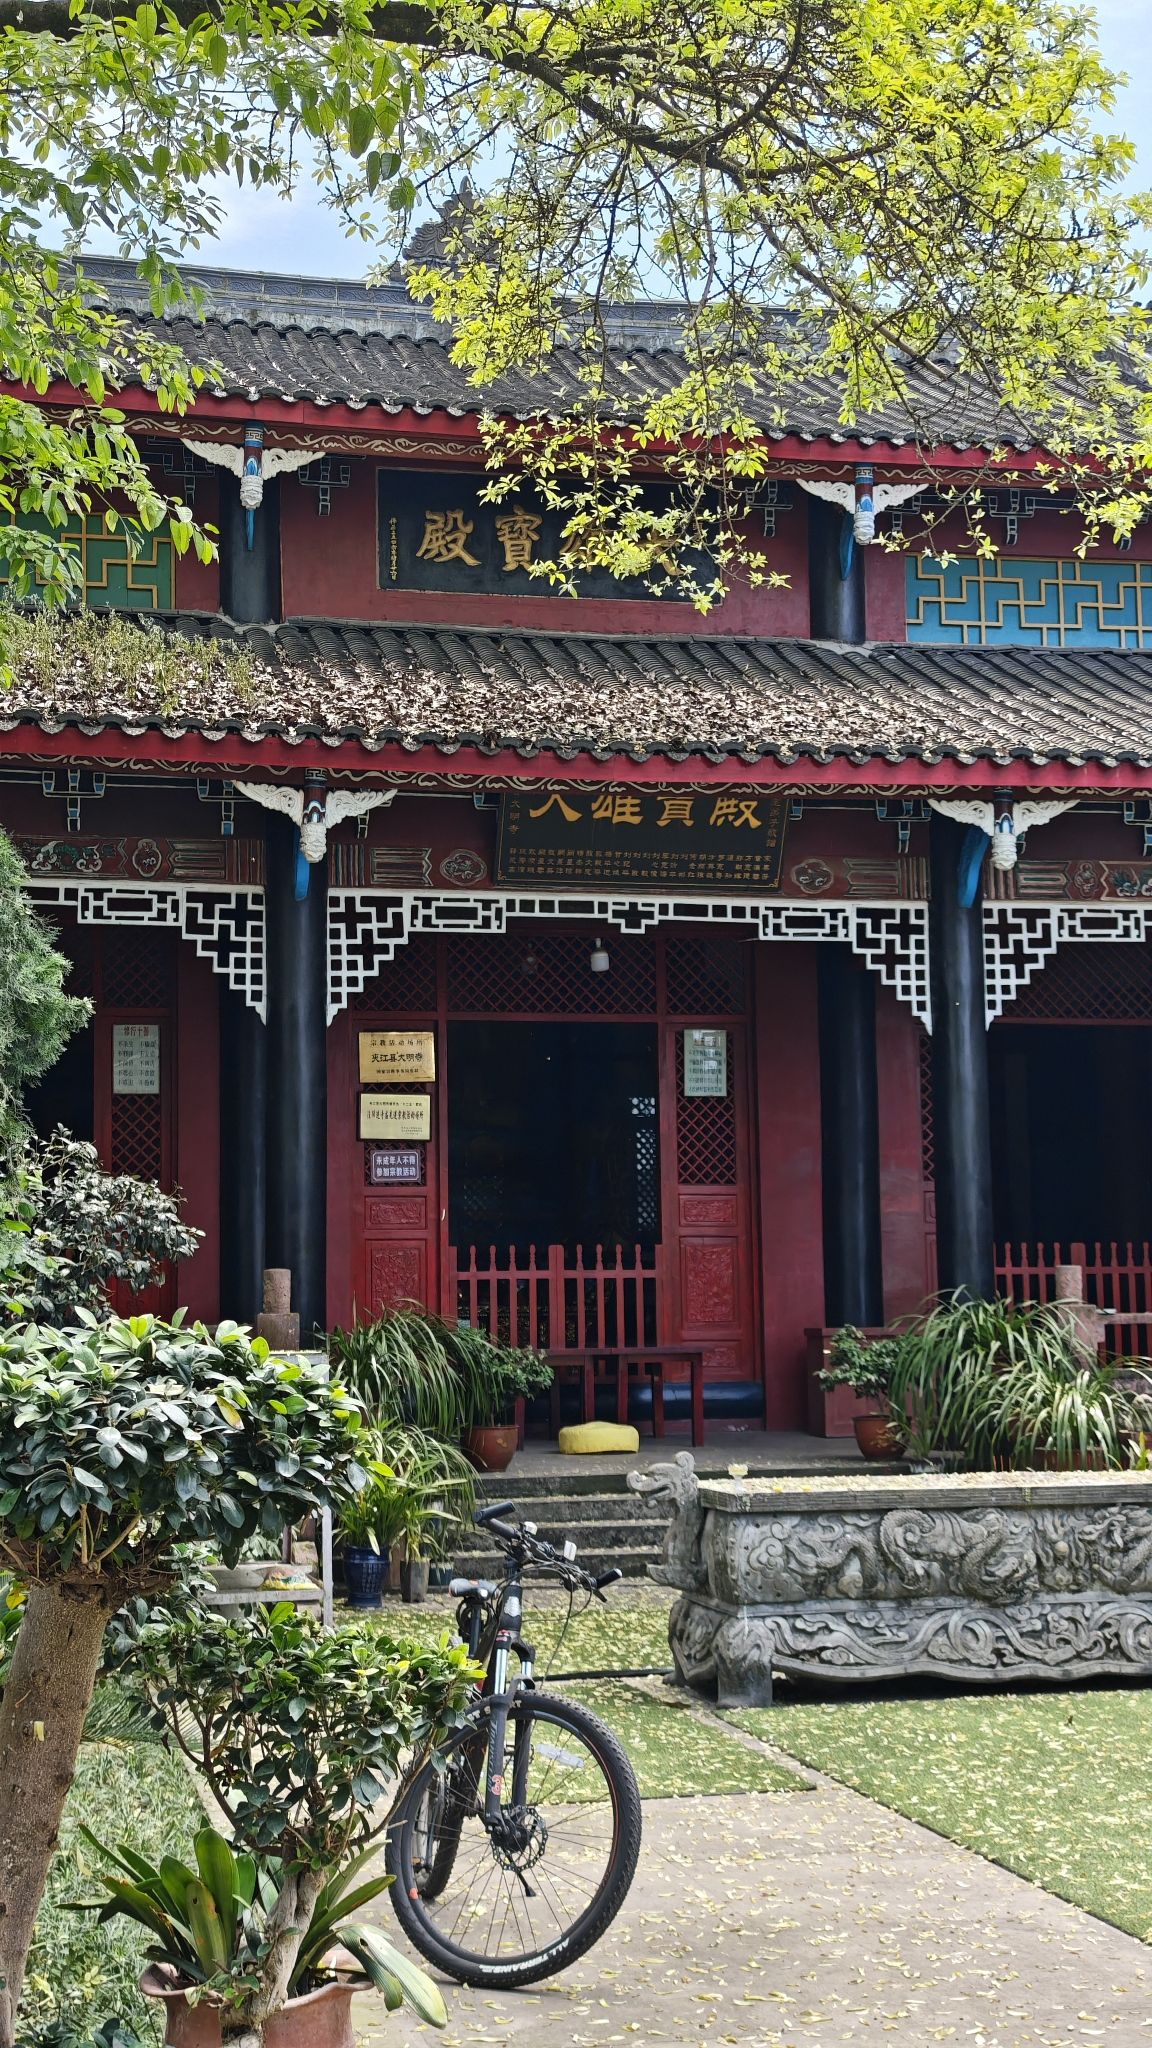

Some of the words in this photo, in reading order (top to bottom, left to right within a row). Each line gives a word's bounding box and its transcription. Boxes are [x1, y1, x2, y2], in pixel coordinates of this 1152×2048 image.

[370, 1039, 423, 1047] 宗教活动场所
[371, 1052, 423, 1063] 夹江县大明寺
[376, 1155, 416, 1166] 未成年人不得
[376, 1167, 416, 1177] 参加宗教活动
